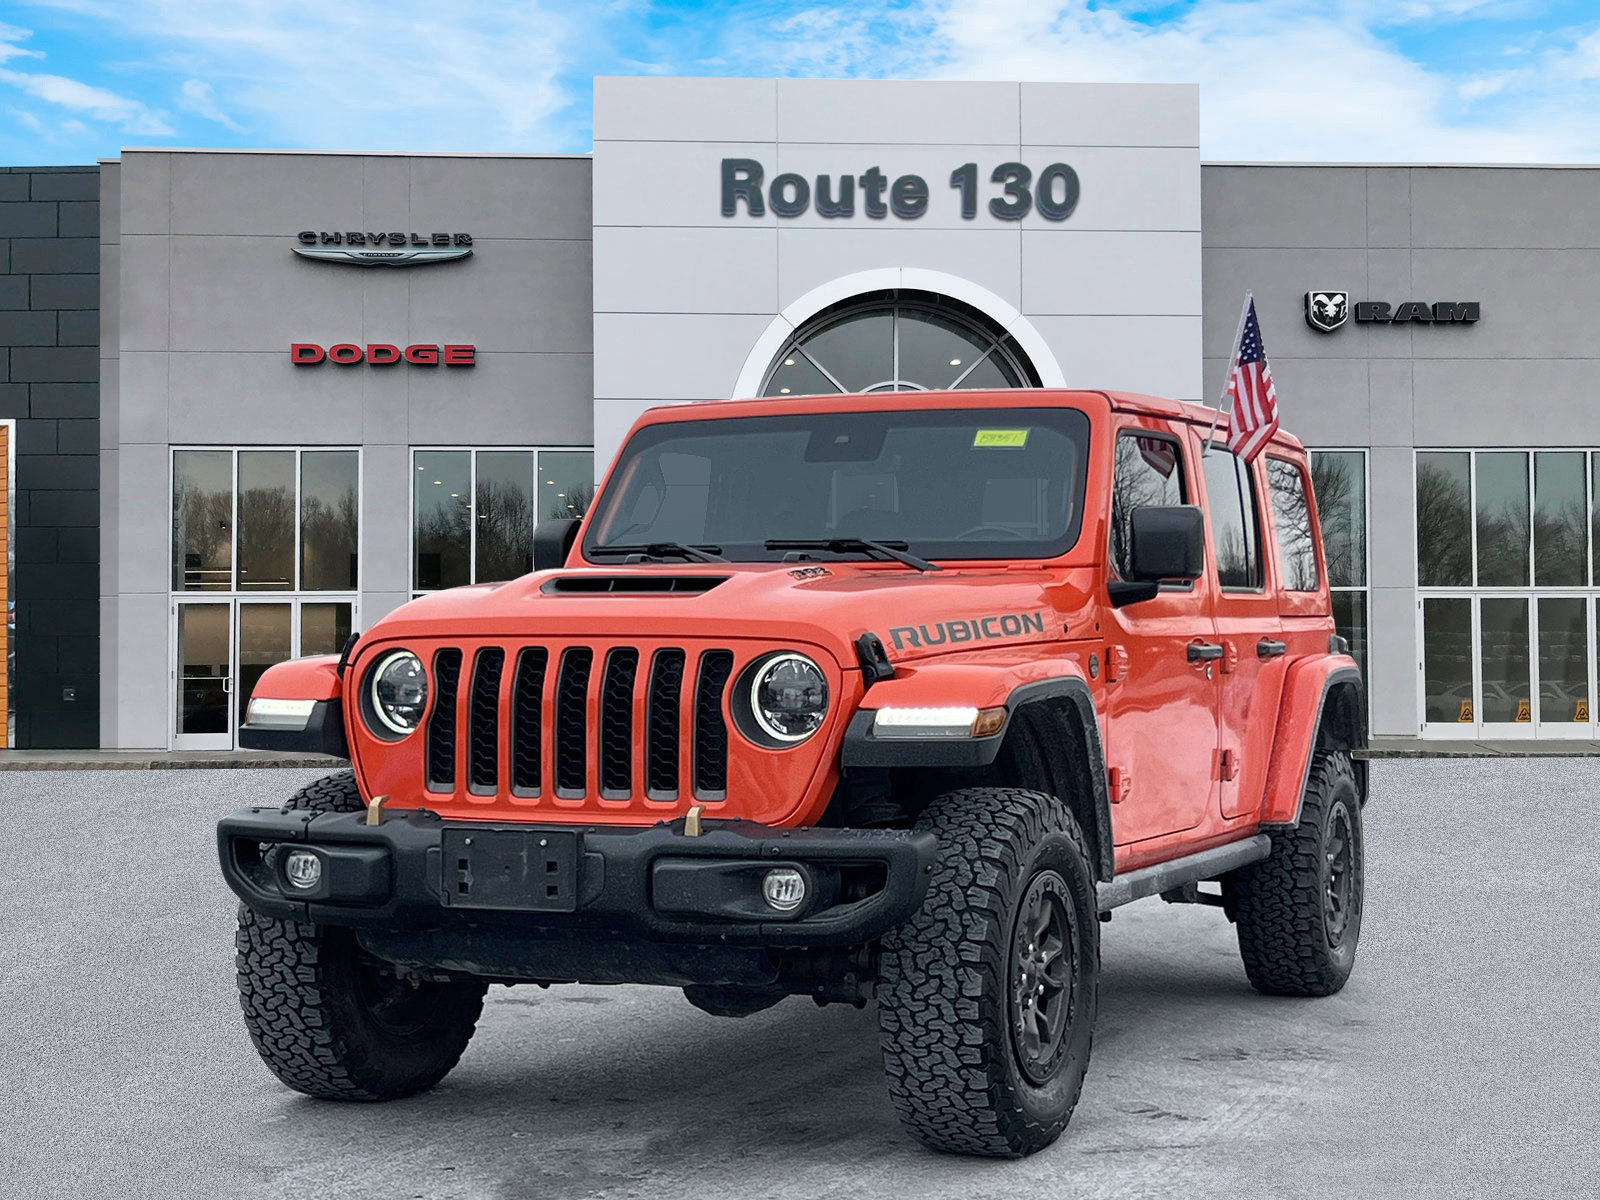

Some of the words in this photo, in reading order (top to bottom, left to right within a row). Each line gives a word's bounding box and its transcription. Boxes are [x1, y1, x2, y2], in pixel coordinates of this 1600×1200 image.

[721, 158, 929, 218] Route
[950, 162, 1080, 220] 130
[298, 231, 473, 245] CHRYSLER
[1354, 302, 1480, 323] RAM
[291, 343, 475, 366] DODGE
[889, 611, 1044, 650] RUBICON
